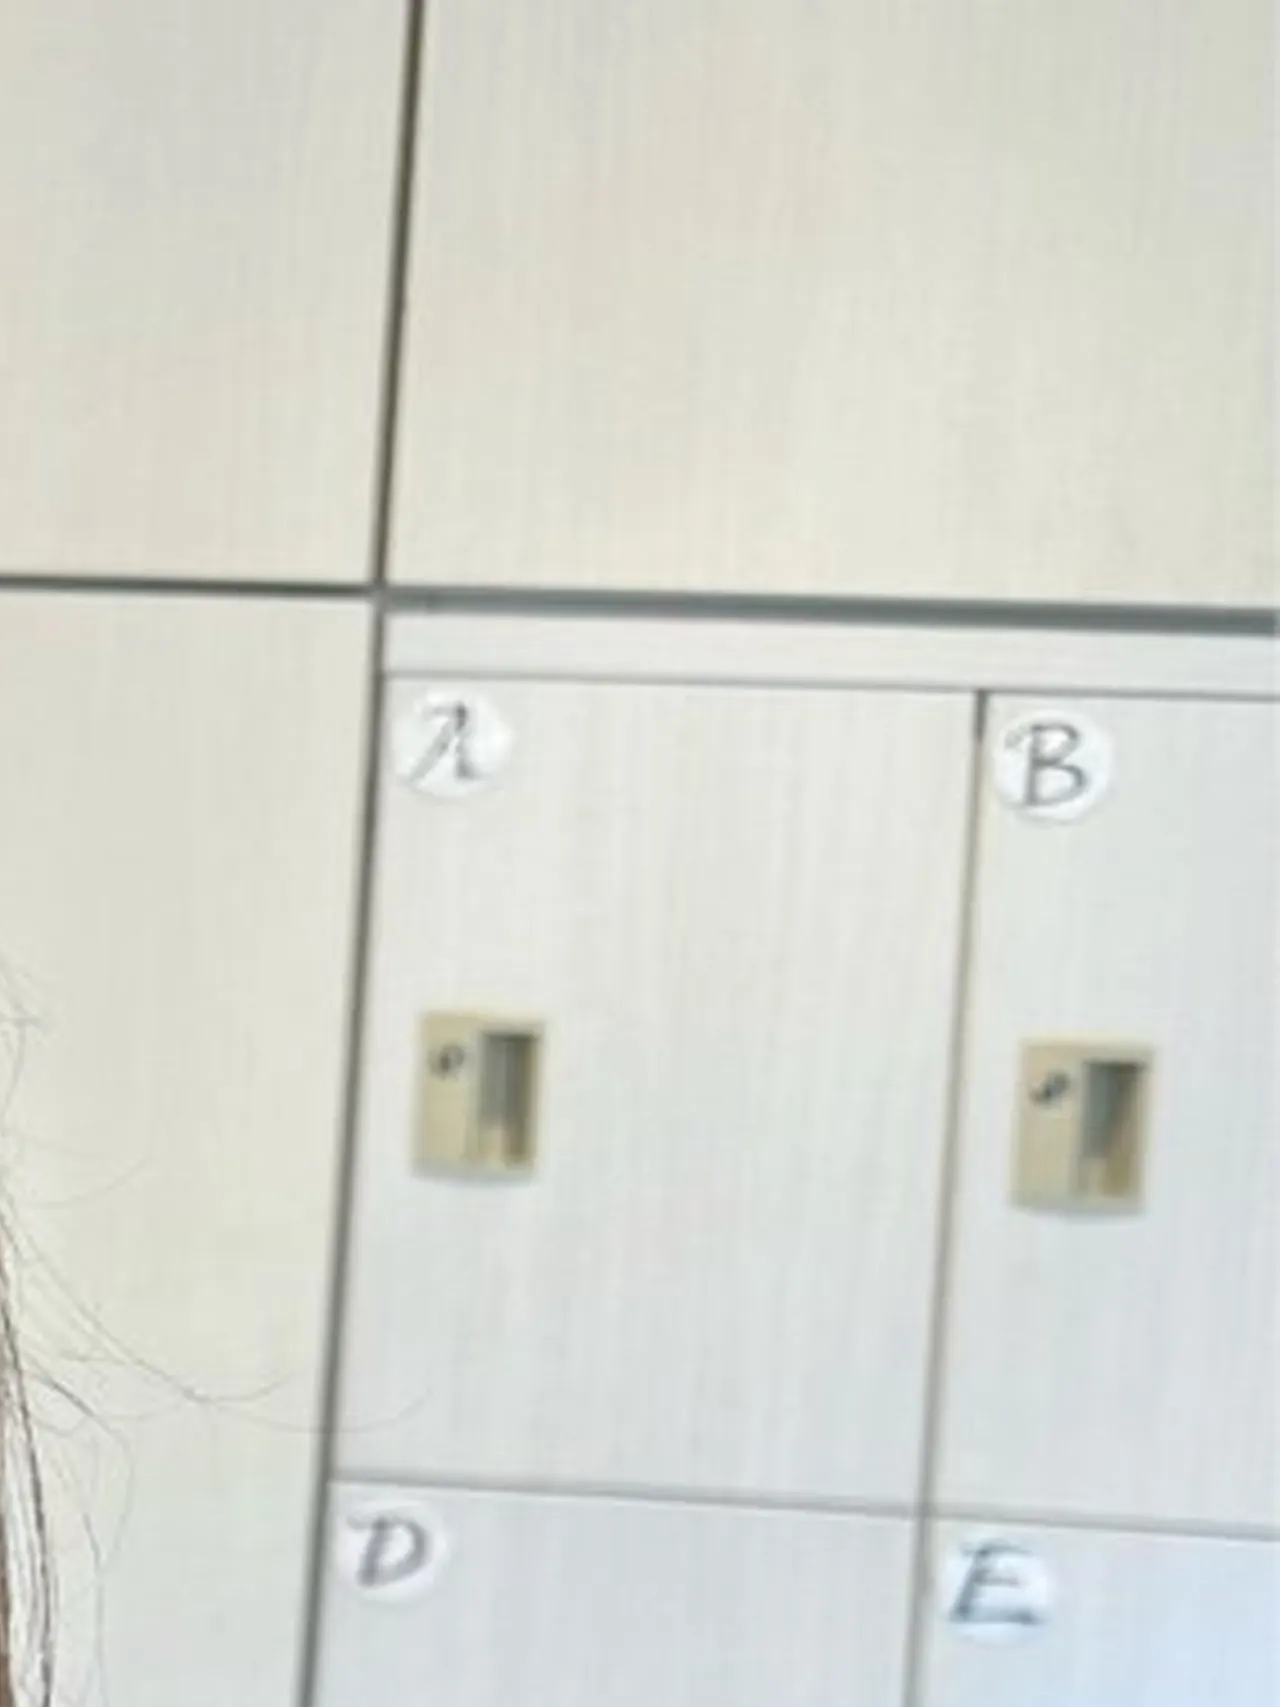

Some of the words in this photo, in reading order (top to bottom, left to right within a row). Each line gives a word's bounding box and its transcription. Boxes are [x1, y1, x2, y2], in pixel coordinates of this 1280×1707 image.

[406, 701, 484, 785] A
[1003, 720, 1088, 807] B
[346, 1513, 432, 1588] D
[948, 1540, 1044, 1625] E
